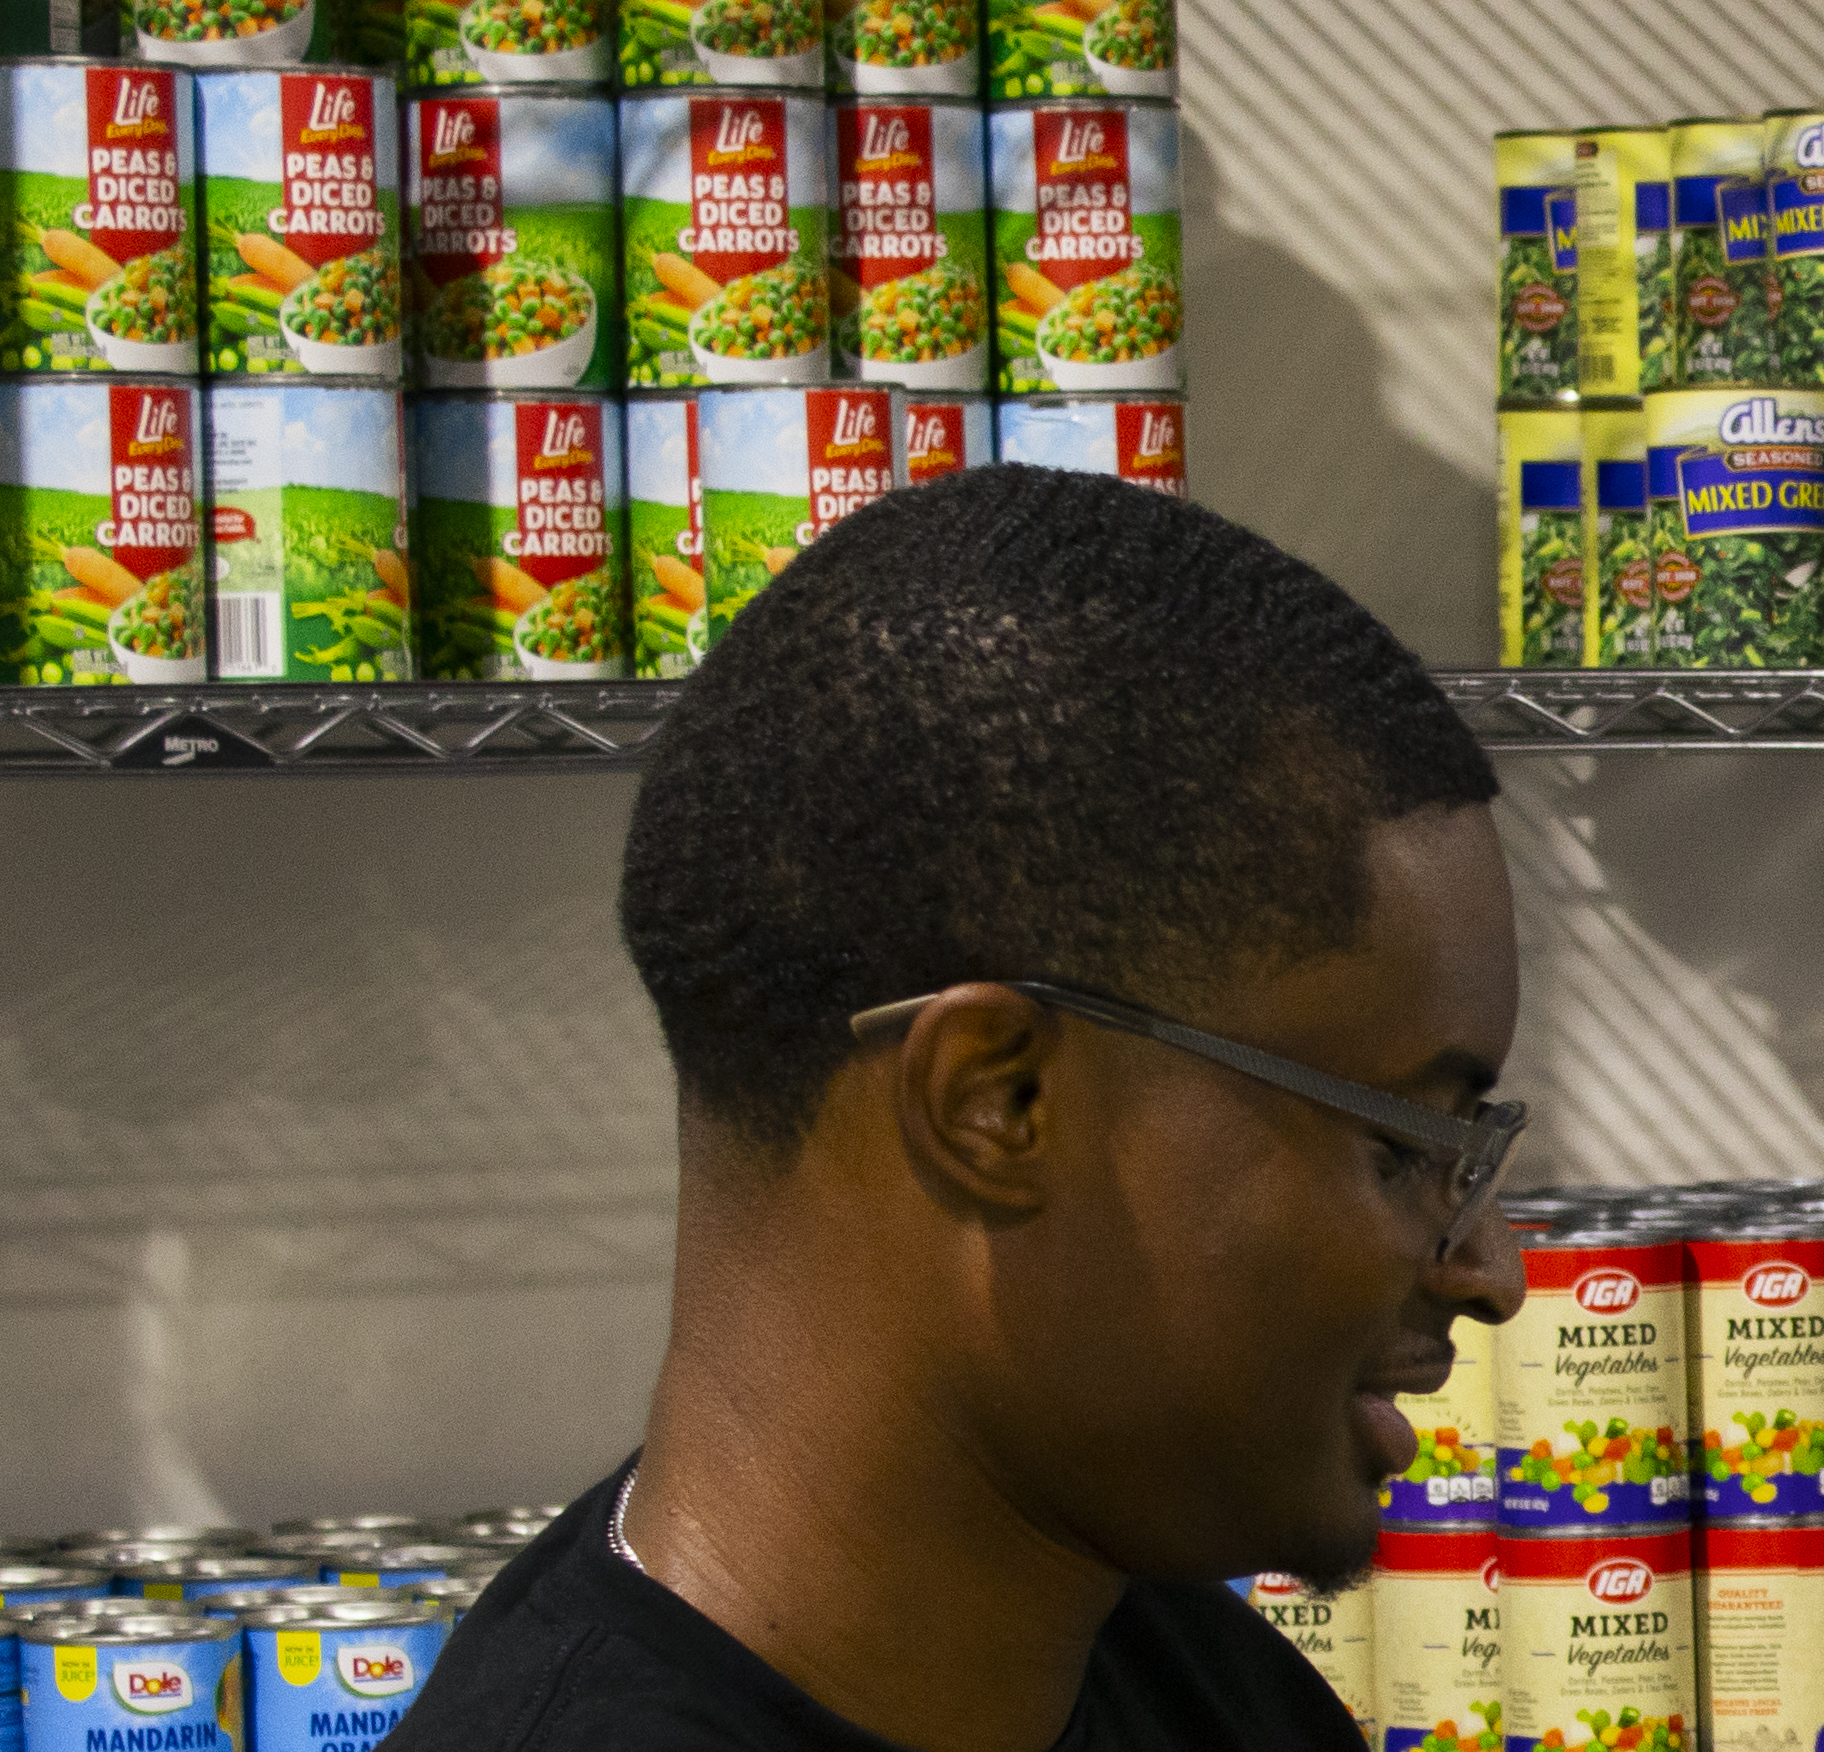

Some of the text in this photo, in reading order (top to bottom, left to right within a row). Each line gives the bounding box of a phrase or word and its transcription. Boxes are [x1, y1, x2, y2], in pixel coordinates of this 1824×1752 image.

[113, 77, 160, 125] Life
[308, 82, 355, 131] Life
[433, 107, 475, 155] Life
[716, 105, 763, 154] Life
[863, 114, 909, 161] Life
[1059, 117, 1105, 163] Life
[92, 148, 161, 175] PEAS
[286, 152, 356, 178] PEAS
[98, 176, 175, 203] DICED
[291, 182, 372, 206] DICED
[421, 176, 475, 200] PEAS
[694, 175, 764, 199] PEAS
[843, 181, 911, 206] PEAS
[1039, 183, 1106, 208] PEAS
[72, 203, 187, 232] CARROTS
[268, 208, 385, 235] CARROTS
[424, 204, 495, 227] DICED
[700, 203, 782, 227] DICED
[846, 207, 929, 232] DICED
[1044, 209, 1125, 234] DICED
[415, 229, 517, 254] ARROTS
[677, 228, 800, 254] CARROTS
[828, 234, 948, 259] CARROTS
[1025, 235, 1144, 261] CARROTS
[137, 394, 178, 443] Life
[834, 398, 875, 445] Life
[542, 409, 586, 458] Life
[1140, 411, 1175, 457] Life
[115, 464, 179, 492] PEAS
[521, 479, 585, 503] PEAS
[811, 468, 876, 492] PEAS
[119, 492, 192, 519] DICED
[1687, 480, 1772, 514] MIXED
[525, 505, 600, 530] DICED
[96, 520, 200, 547] CARROTS
[502, 531, 613, 556] CARROTS
[164, 736, 219, 752] METRO
[1584, 1279, 1633, 1307] IGA
[1751, 1273, 1803, 1299] IGA
[1558, 1323, 1657, 1348] MIXED
[1554, 1351, 1660, 1388] Vegetables
[1595, 1568, 1647, 1595] IGA
[1570, 1612, 1668, 1638] MIXED
[353, 1655, 404, 1679] Dole
[1567, 1641, 1670, 1678] Vegetables
[129, 1671, 182, 1694] Dole
[310, 1709, 400, 1737] MANDA
[86, 1722, 217, 1752] MANDARIN
